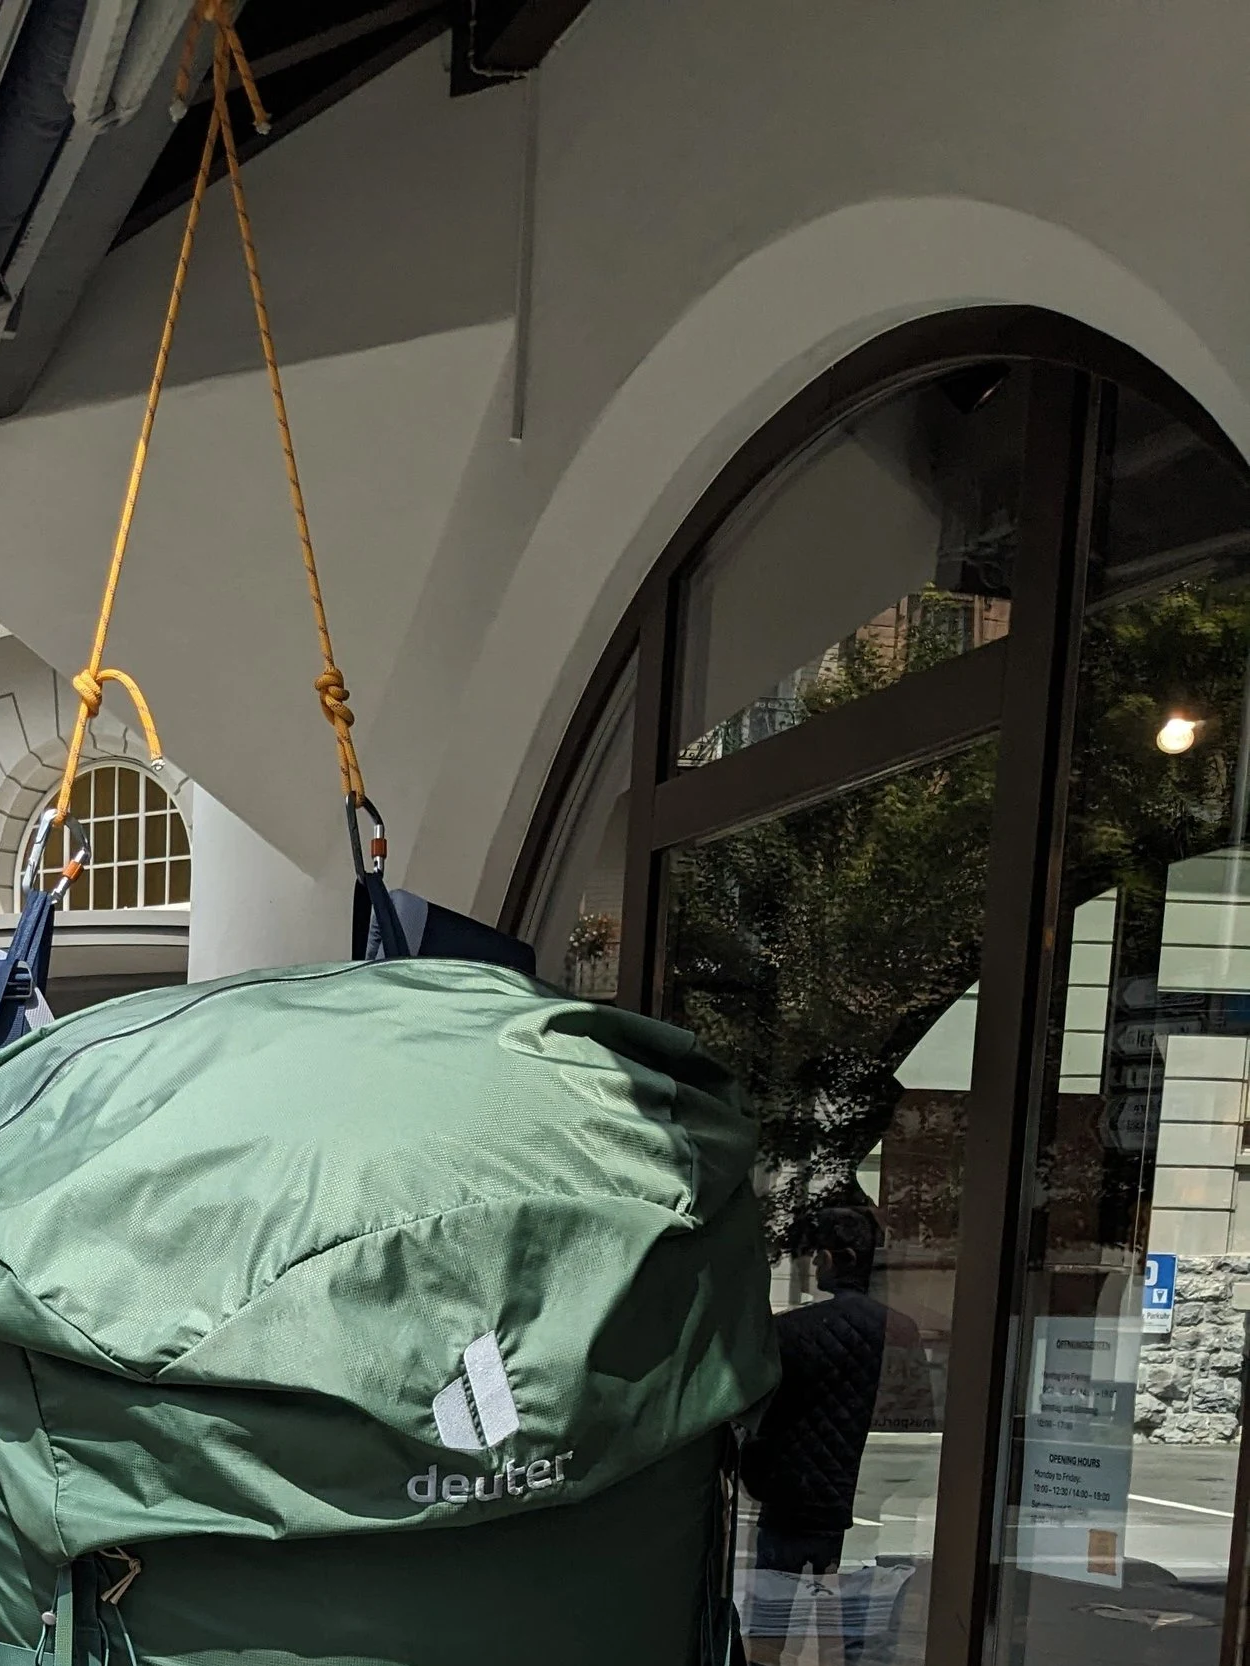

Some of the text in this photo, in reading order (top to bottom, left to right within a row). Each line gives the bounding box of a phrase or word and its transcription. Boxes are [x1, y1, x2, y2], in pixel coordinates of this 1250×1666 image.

[1049, 1453, 1101, 1468] OPENING HOURS
[407, 1450, 574, 1505] deuter
[1034, 1469, 1055, 1482] Monday
[1056, 1473, 1062, 1481] to
